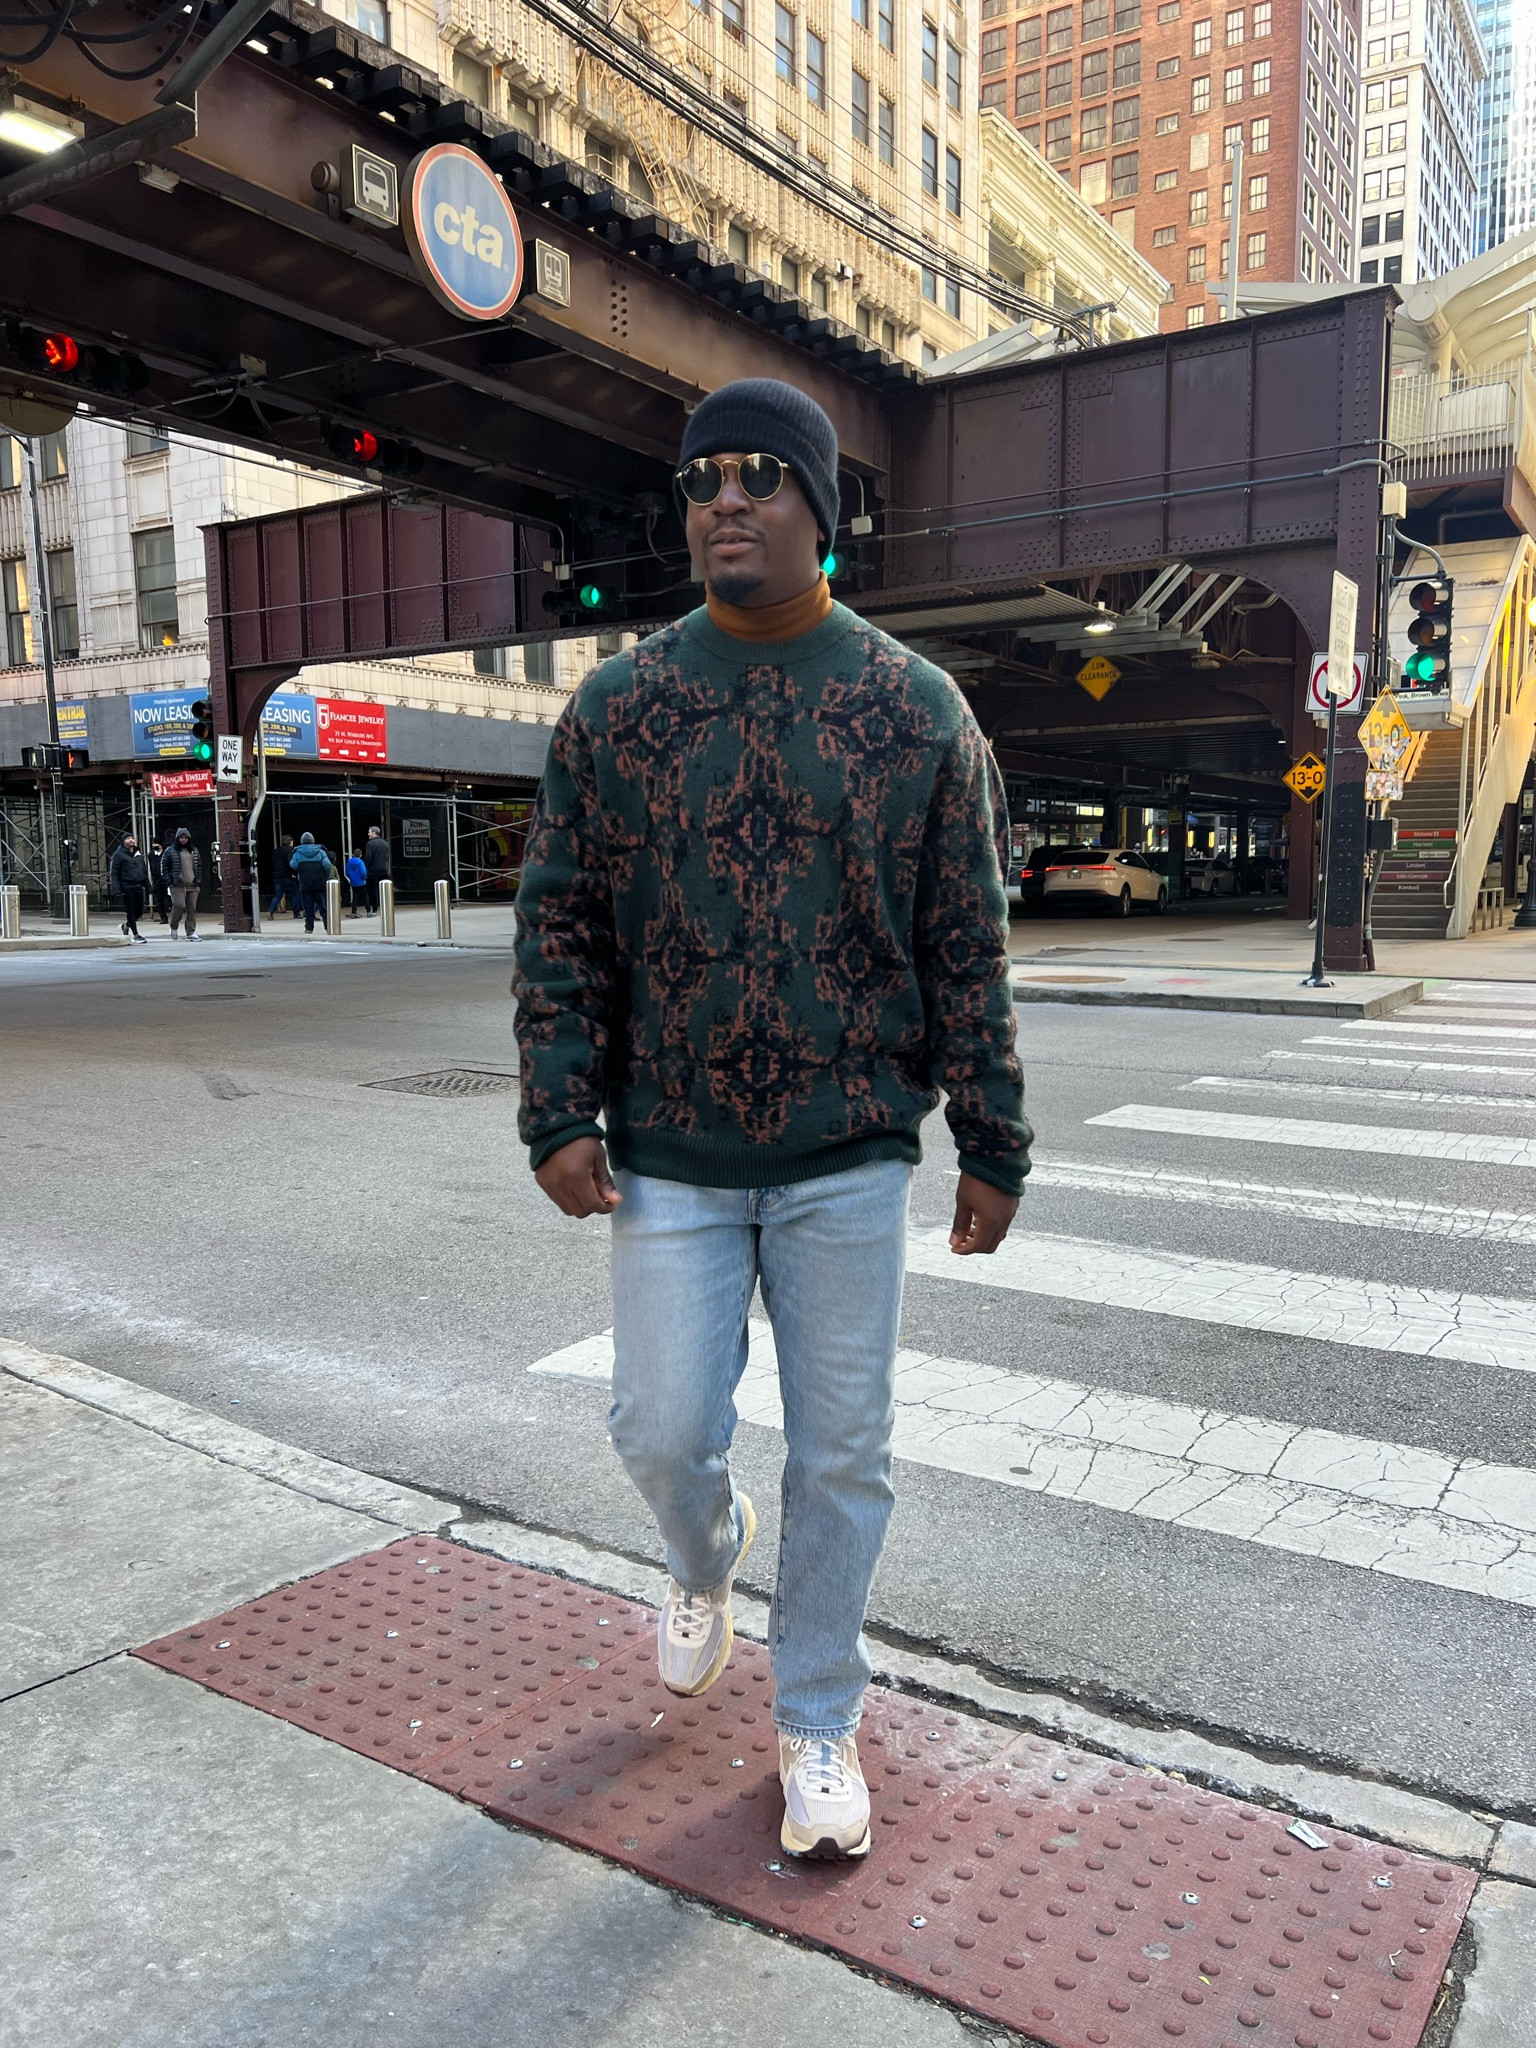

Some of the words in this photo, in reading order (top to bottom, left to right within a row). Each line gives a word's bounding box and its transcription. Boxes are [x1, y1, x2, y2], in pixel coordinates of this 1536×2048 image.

[434, 202, 503, 269] cta
[1080, 671, 1116, 680] CLEARANCE
[134, 707, 162, 723] NOW
[164, 704, 194, 721] LEASI
[262, 707, 311, 724] EASING
[330, 712, 357, 722] FIANCEE
[358, 715, 385, 725] JEWELRY
[223, 739, 238, 750] ONE
[222, 752, 238, 762] WAY
